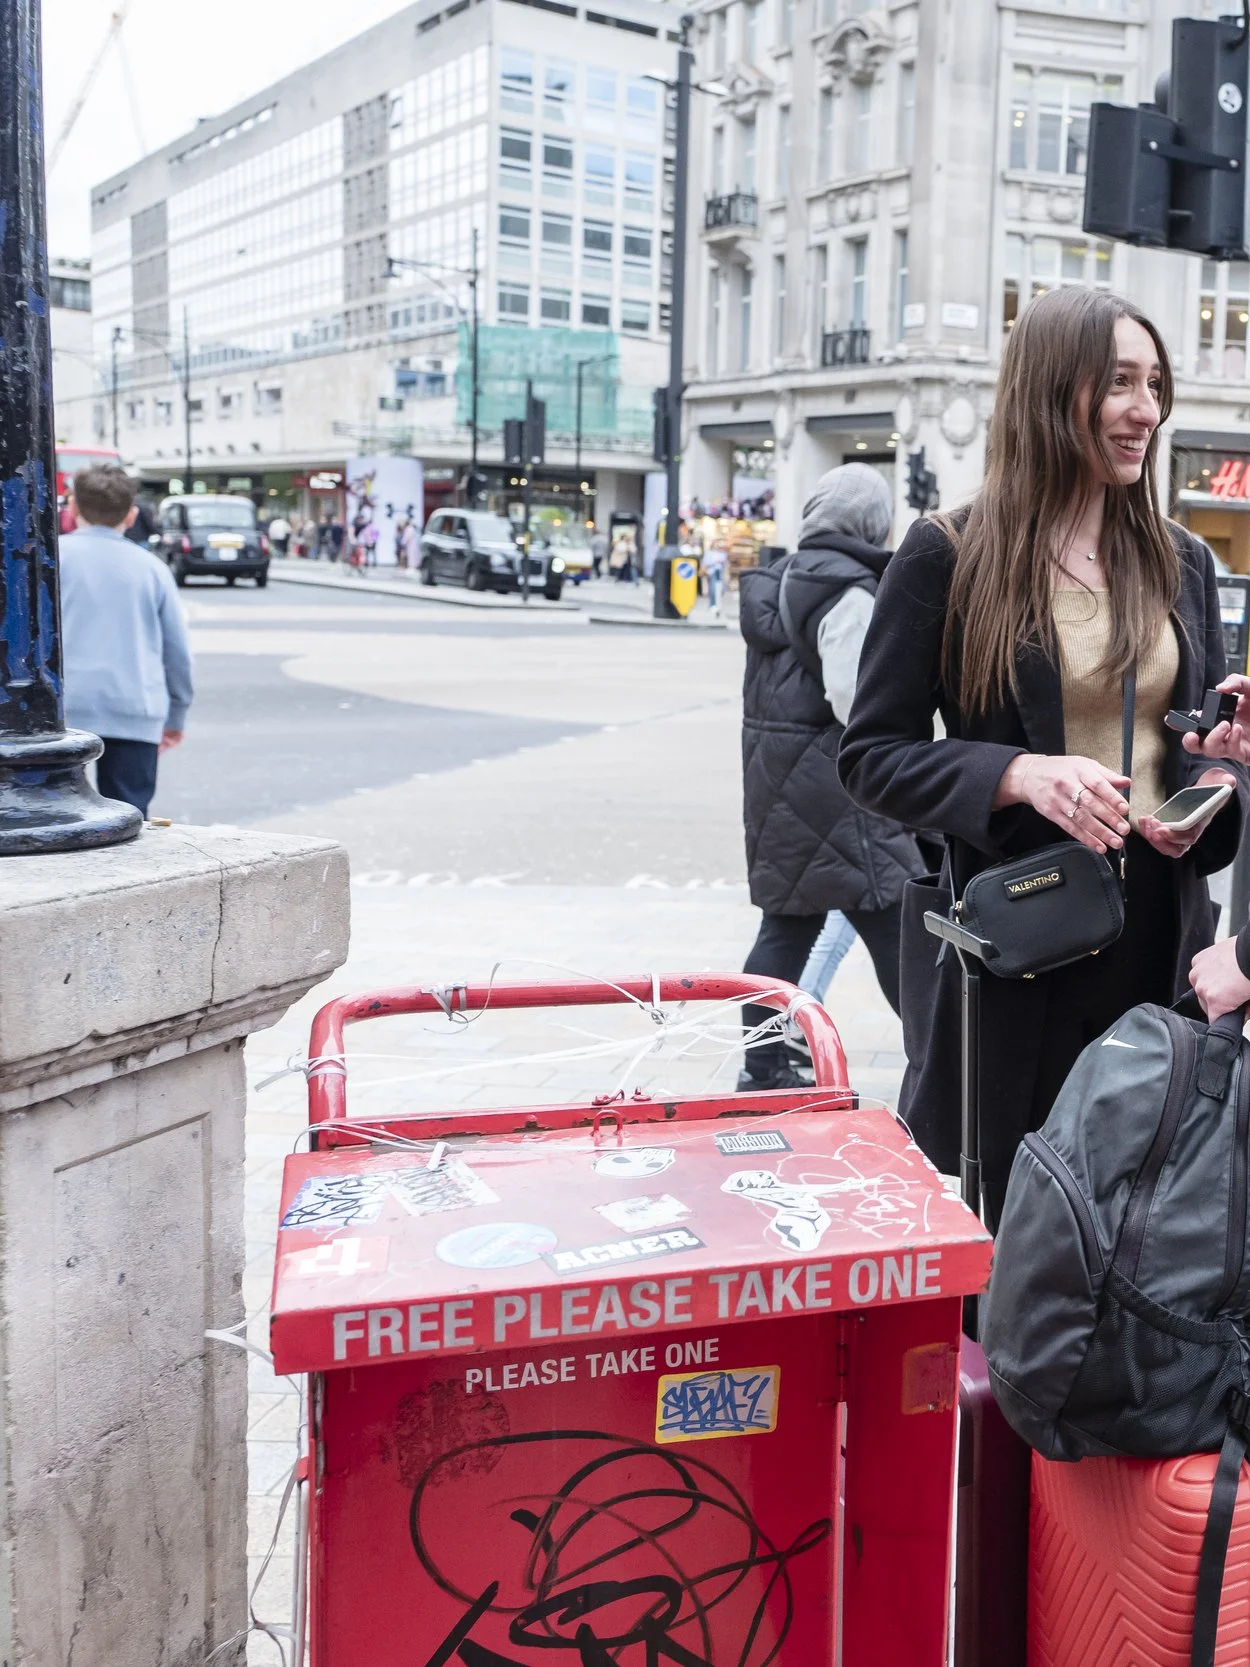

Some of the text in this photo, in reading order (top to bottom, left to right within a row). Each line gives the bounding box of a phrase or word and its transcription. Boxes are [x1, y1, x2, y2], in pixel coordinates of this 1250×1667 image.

[1008, 872, 1060, 894] VALENTINO
[721, 1134, 782, 1149] MISSION
[334, 1251, 943, 1361] FREE PLEASE TAKE ONE
[465, 1338, 720, 1394] PLEASE TAKE ONE
